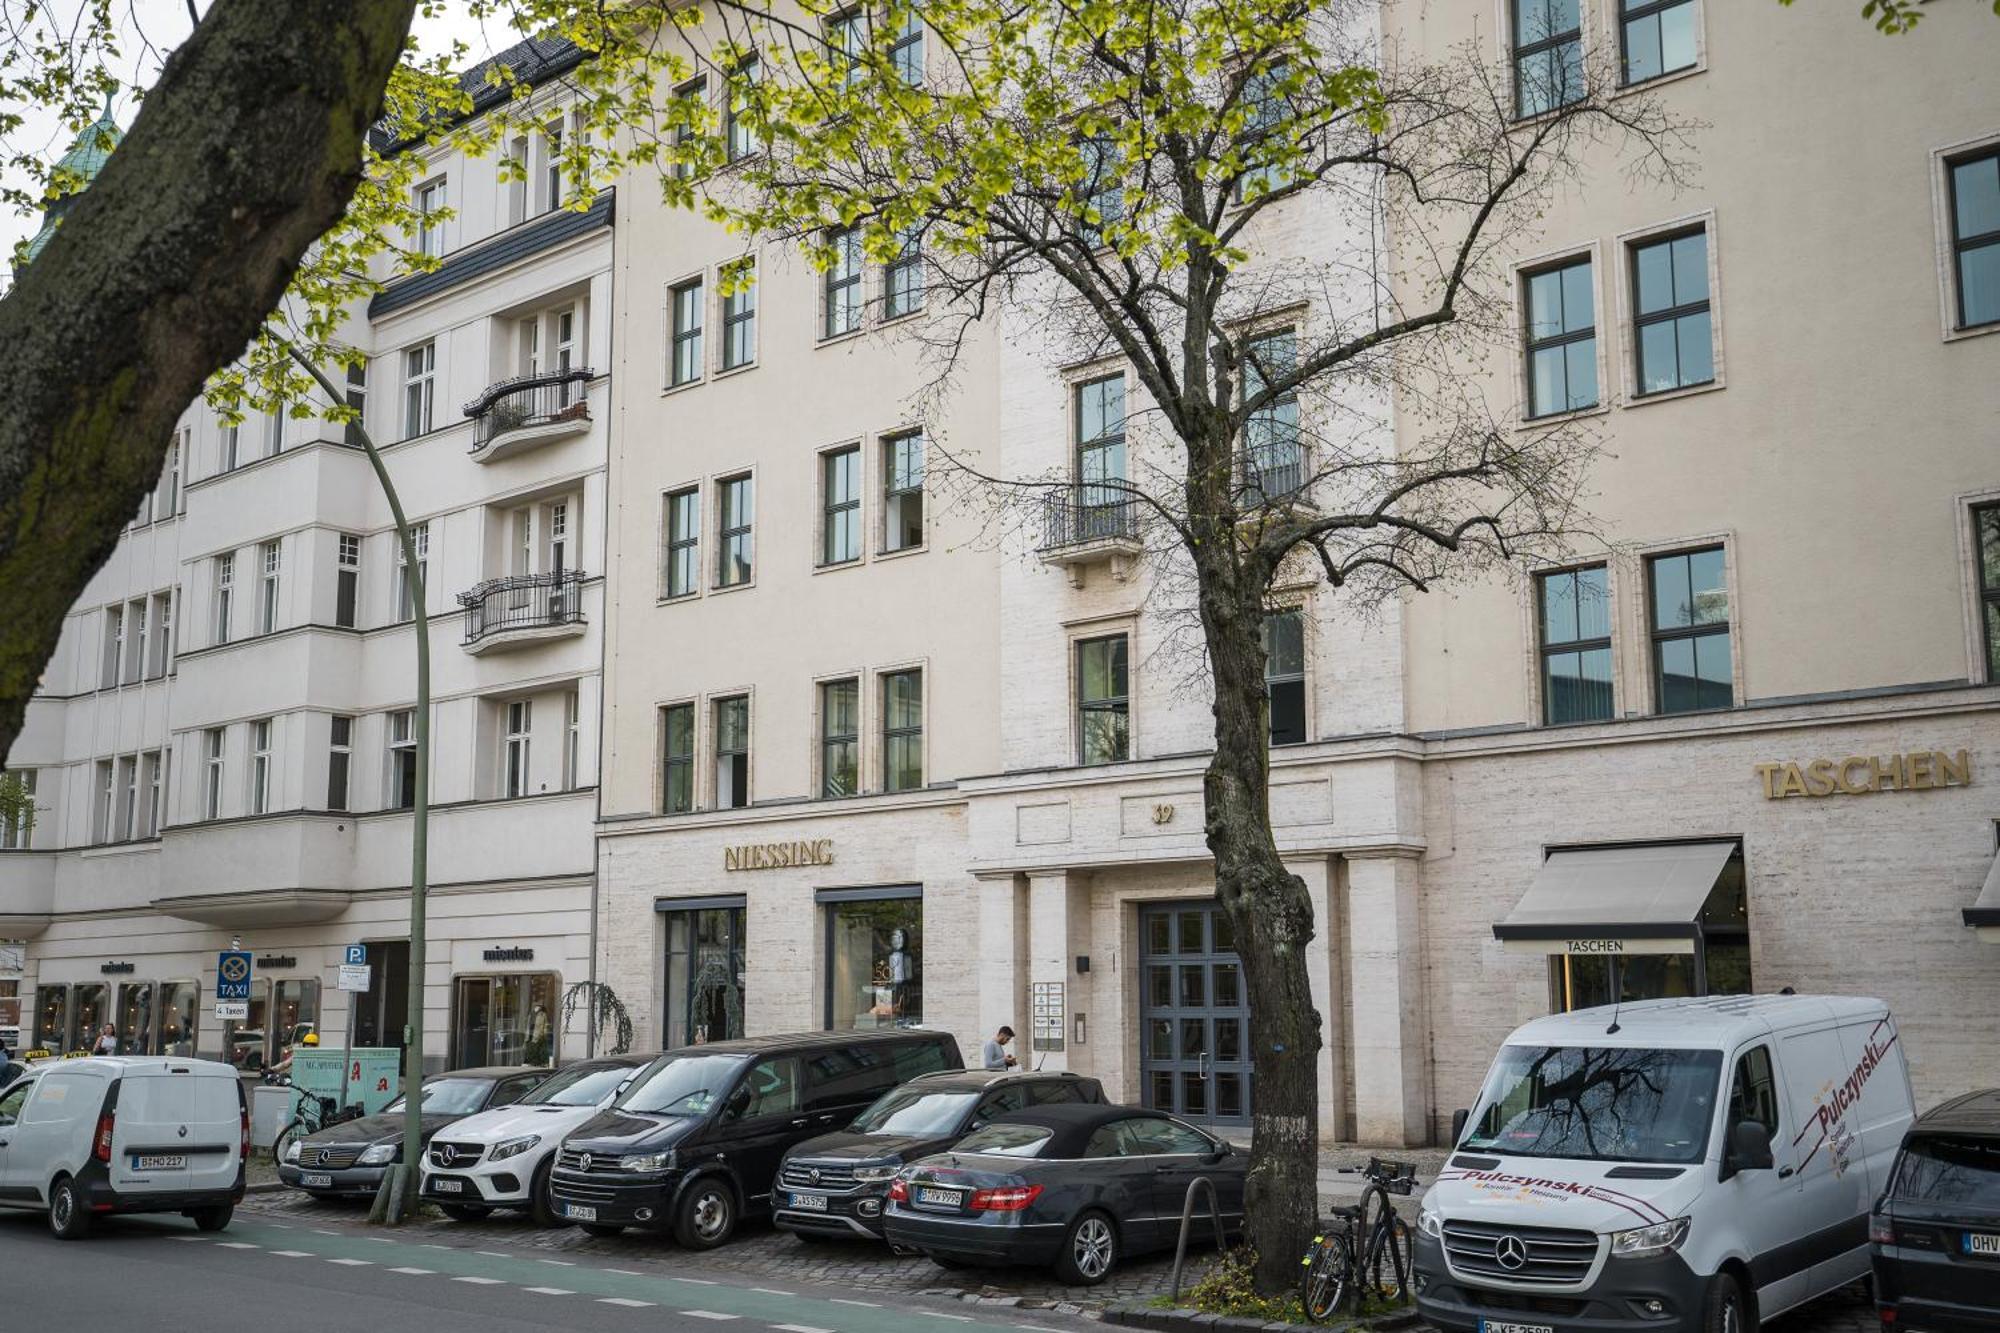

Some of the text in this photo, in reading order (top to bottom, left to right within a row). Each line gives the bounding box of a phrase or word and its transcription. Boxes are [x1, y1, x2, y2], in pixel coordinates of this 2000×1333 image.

[1755, 749, 1969, 800] TASCHEN
[1152, 803, 1174, 825] 39
[725, 839, 832, 871] NIESSING
[1566, 940, 1624, 953] TASCHEN
[349, 948, 361, 962] P
[220, 984, 247, 996] TAXI
[226, 1007, 245, 1015] Taxen
[1817, 1036, 1881, 1136] Pulczynski
[166, 1156, 183, 1166] 217
[1461, 1170, 1593, 1196] Pulczynski
[1972, 1236, 1998, 1251] OHV
